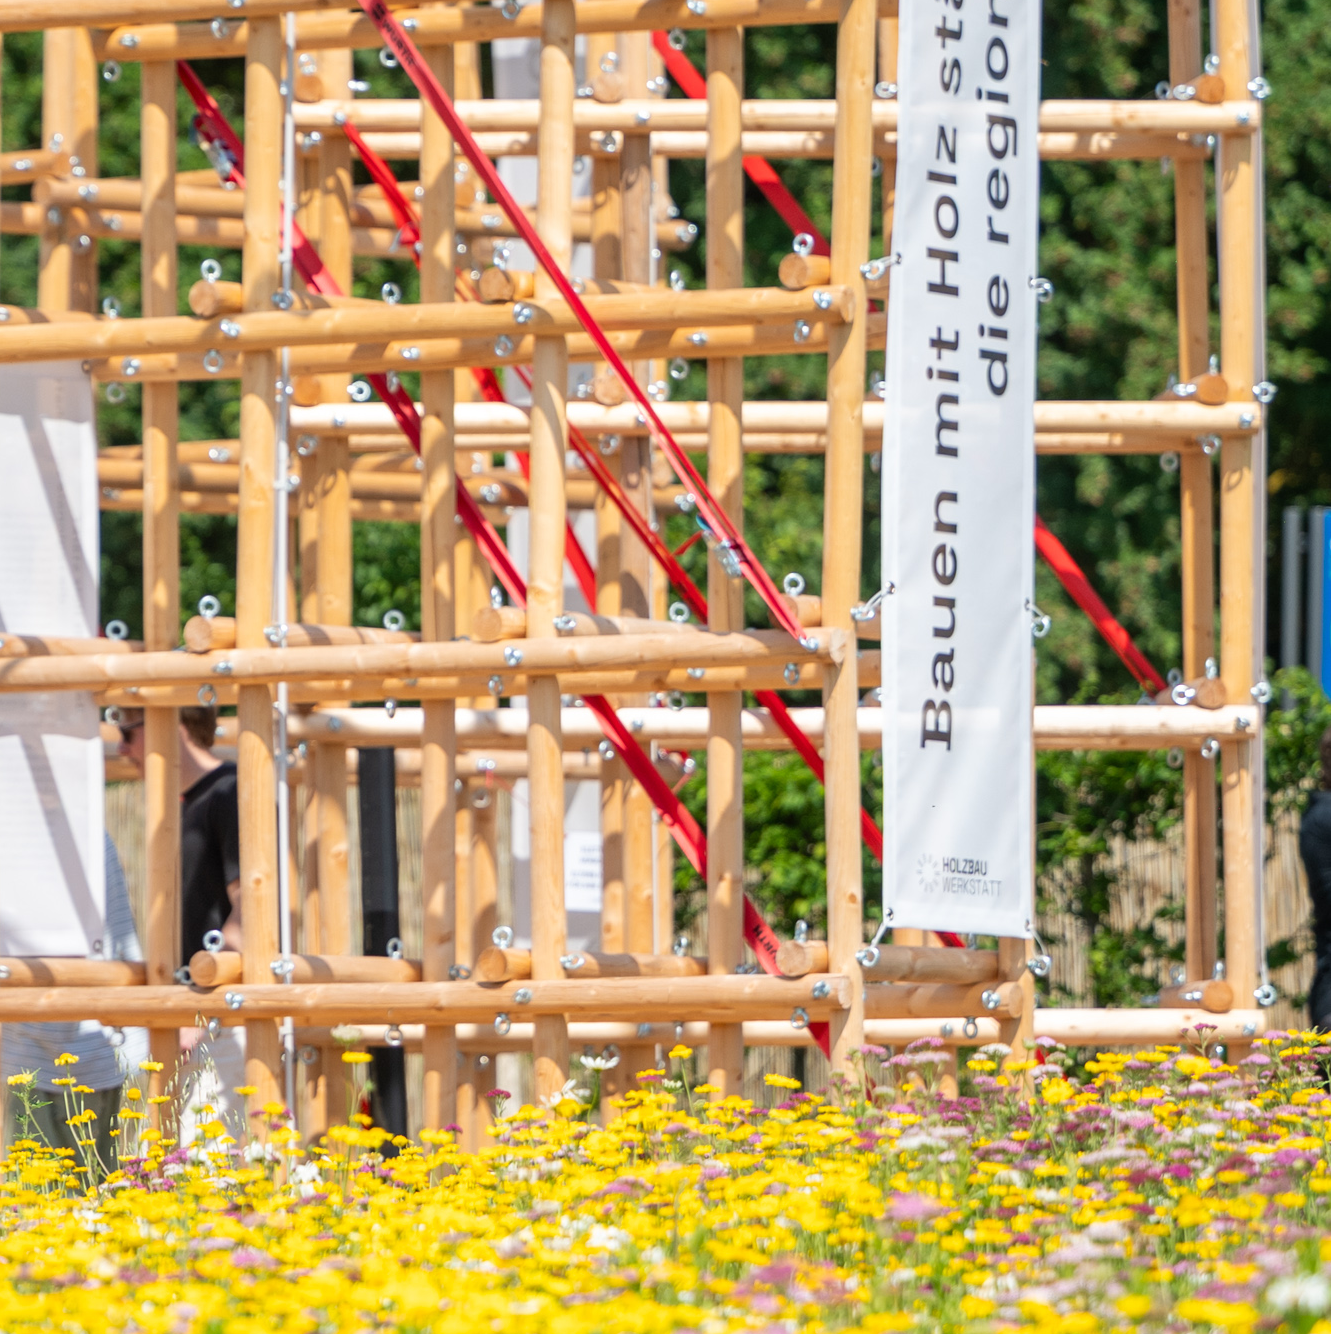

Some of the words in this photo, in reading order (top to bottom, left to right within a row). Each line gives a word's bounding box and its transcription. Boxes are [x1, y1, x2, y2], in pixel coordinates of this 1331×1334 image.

[926, 124, 961, 298] Holz
[926, 325, 961, 459] mit
[977, 274, 1011, 398] die
[919, 490, 959, 752] Bauen
[942, 856, 988, 876] HOLZBAU
[942, 876, 1002, 897] WERKSTATT
